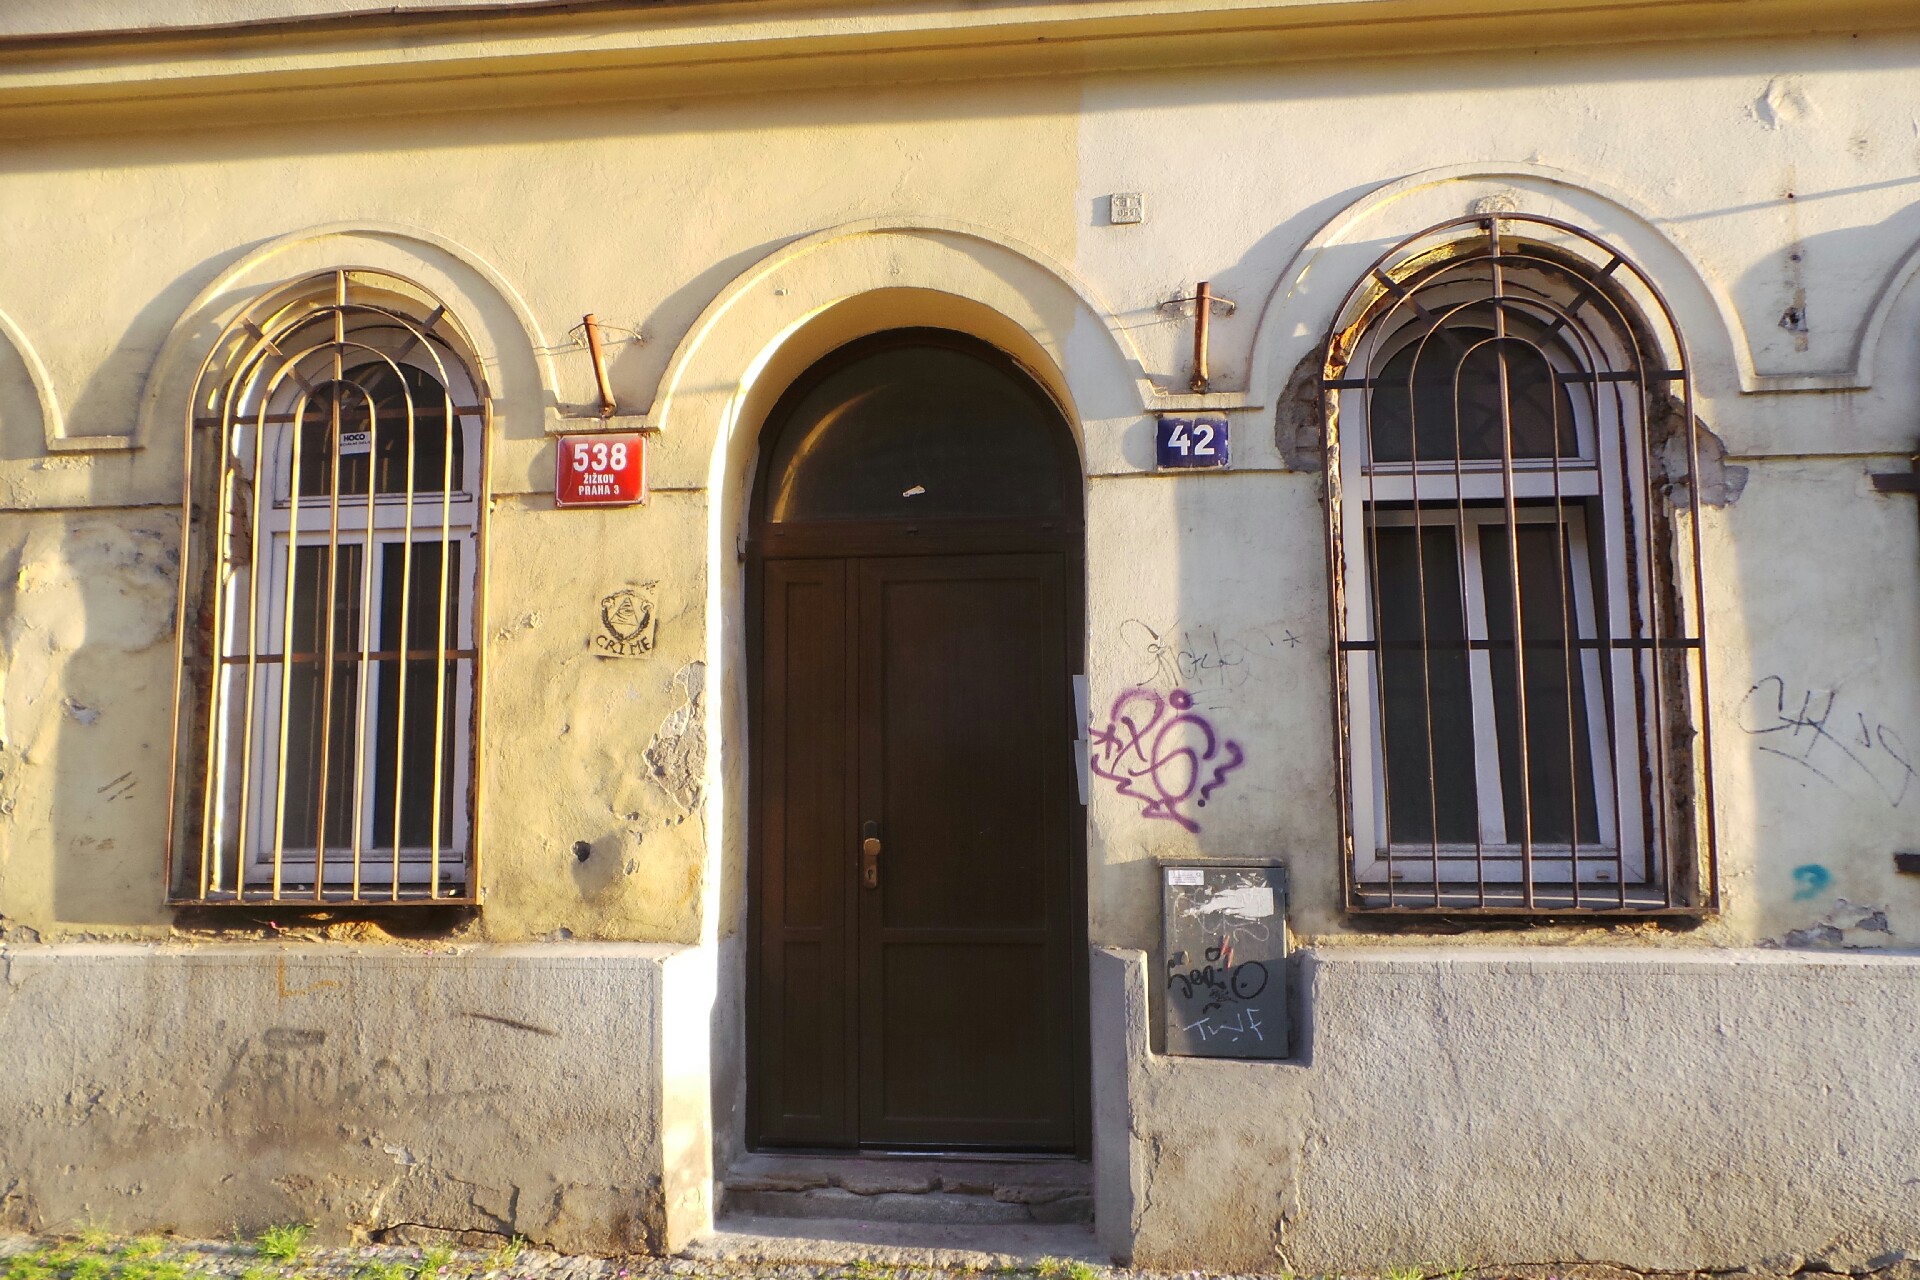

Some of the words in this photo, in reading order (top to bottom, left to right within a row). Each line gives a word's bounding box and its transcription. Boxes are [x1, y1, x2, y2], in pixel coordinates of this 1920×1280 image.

[343, 433, 366, 442] HOCO
[1167, 424, 1215, 456] 42
[573, 442, 627, 472] 538
[583, 472, 614, 485] ŽIŽKOV
[578, 485, 611, 496] PRAHA
[613, 484, 620, 495] 3
[596, 634, 651, 656] CRIME
